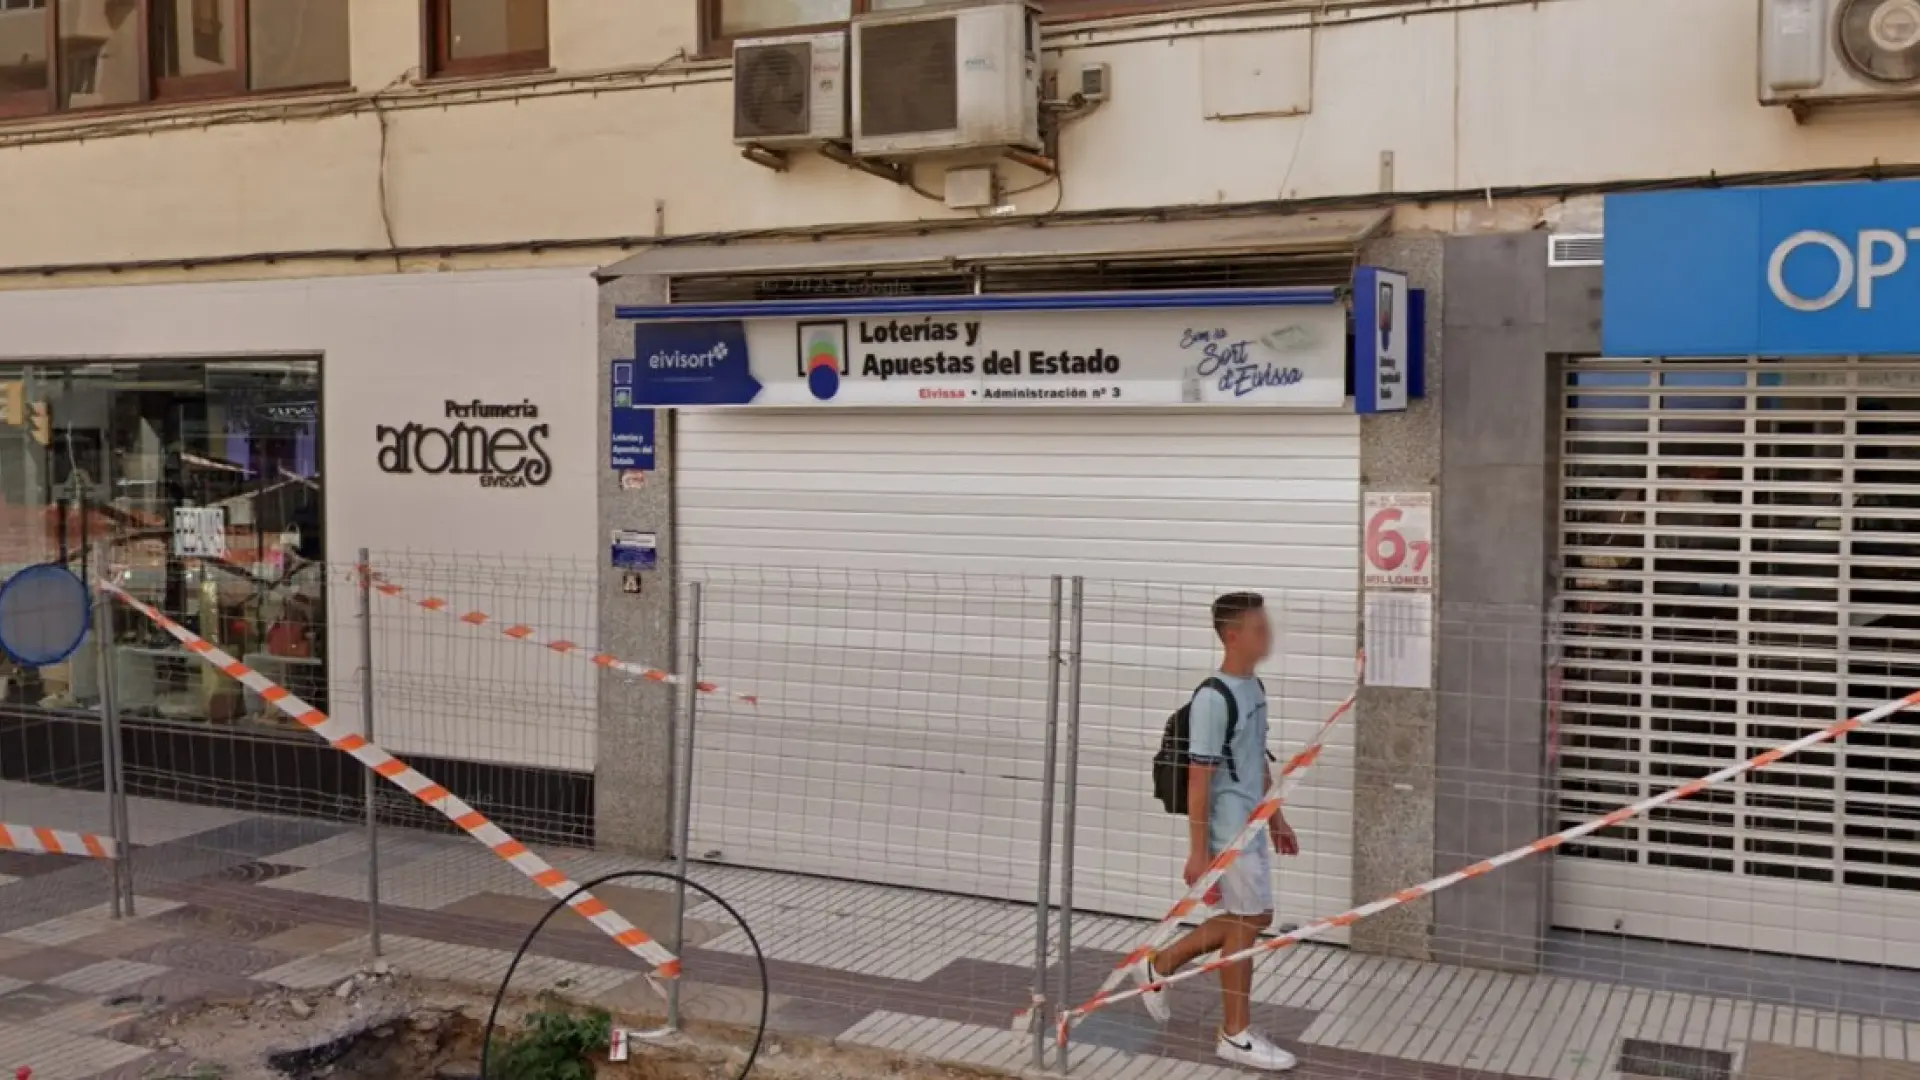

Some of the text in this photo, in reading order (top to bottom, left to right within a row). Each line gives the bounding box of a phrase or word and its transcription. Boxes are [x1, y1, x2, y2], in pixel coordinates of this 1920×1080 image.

[1767, 227, 1920, 312] OP
[860, 316, 981, 347] Loterías y
[649, 349, 715, 369] eivisort
[862, 348, 1120, 380] Apuestas del Estado
[1197, 340, 1258, 376] Sort
[918, 388, 967, 399] Eivissa
[984, 386, 1088, 399] Administración
[1112, 387, 1122, 399] 3
[376, 420, 552, 486] aromes
